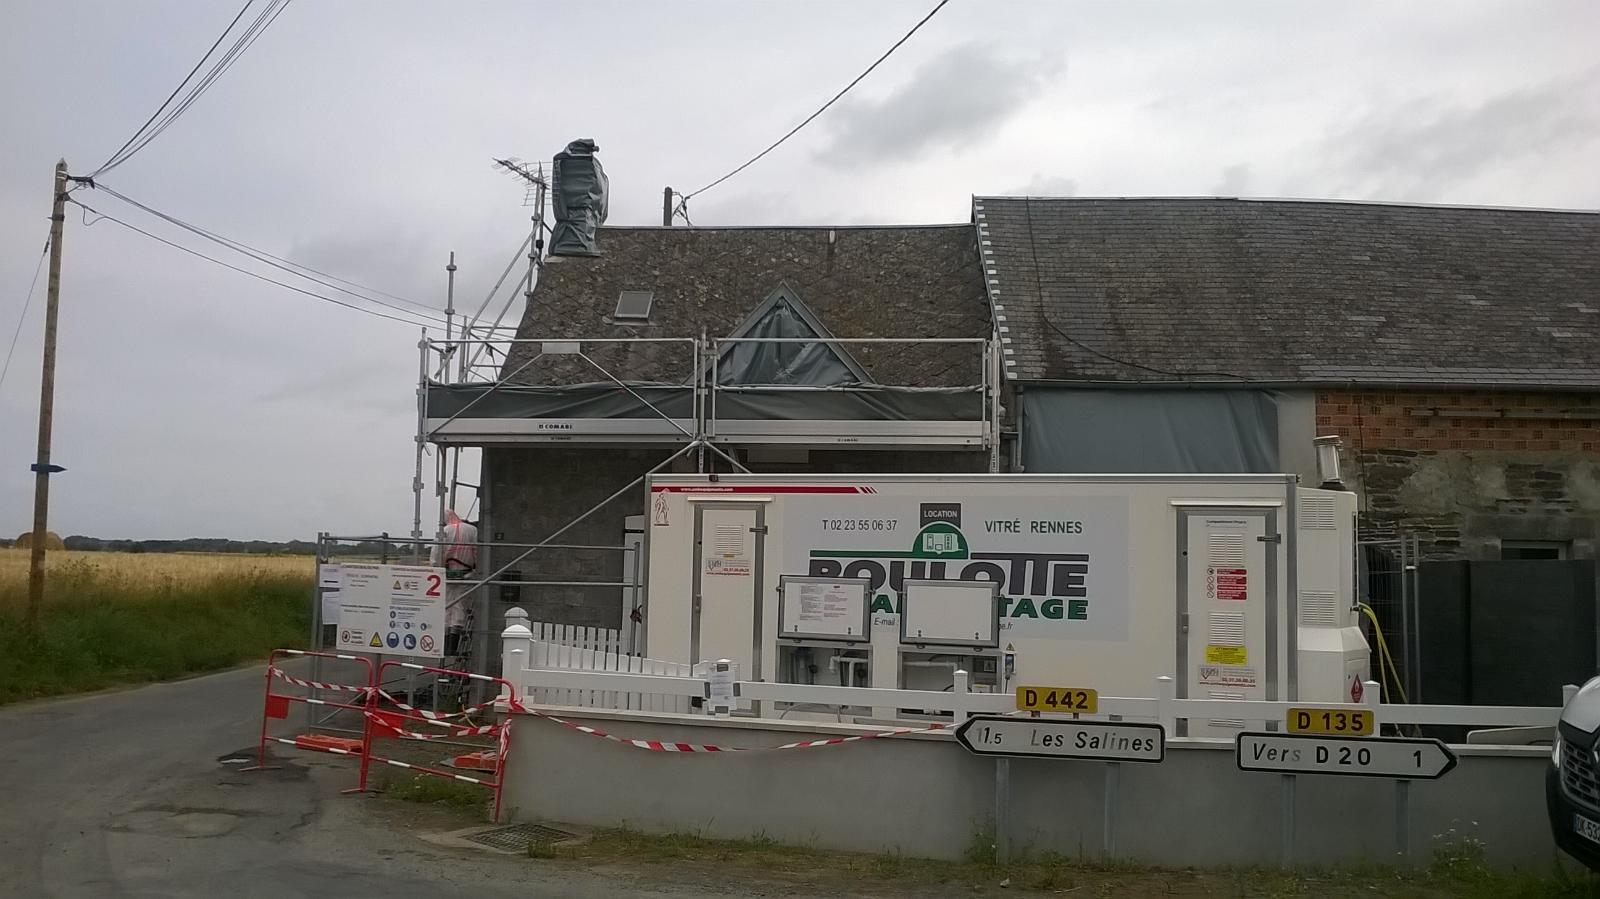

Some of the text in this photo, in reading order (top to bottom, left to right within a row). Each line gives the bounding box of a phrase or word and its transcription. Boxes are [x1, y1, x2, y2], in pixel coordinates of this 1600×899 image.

[923, 510, 958, 519] LOCATION
[822, 519, 898, 531] T 02 23 55 06 37
[984, 518, 1083, 534] VITRÉ RENNES
[426, 574, 441, 596] 2
[873, 617, 895, 626] E-mail
[1025, 690, 1089, 710] D 442
[1297, 712, 1364, 732] D 135
[1030, 729, 1064, 748] Les
[1074, 731, 1155, 752] Salines
[1253, 742, 1422, 768] Vers D 20 1
[1576, 816, 1600, 841] DK-53
